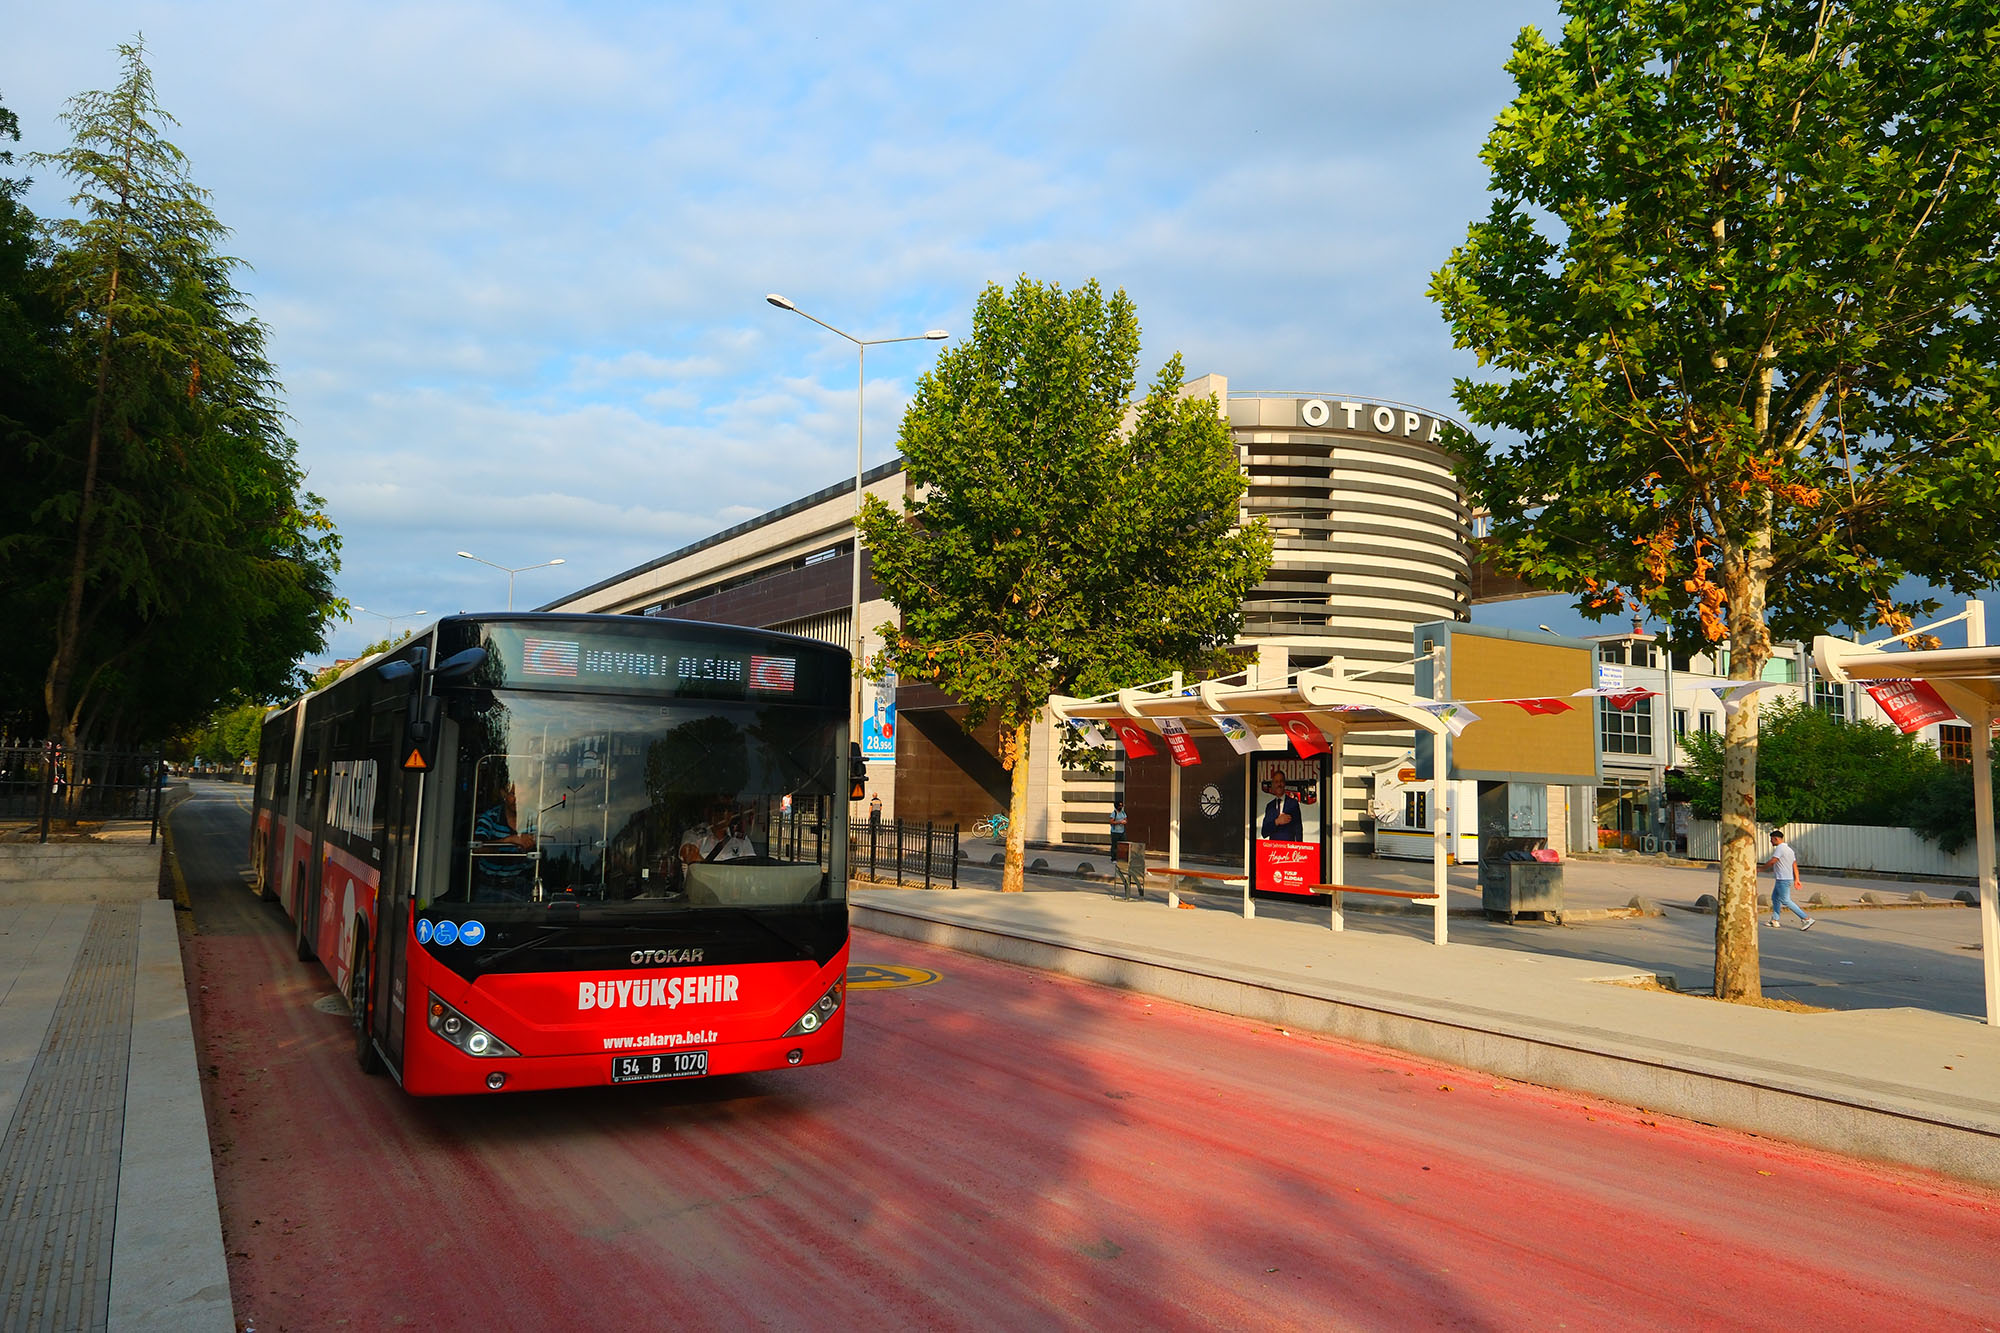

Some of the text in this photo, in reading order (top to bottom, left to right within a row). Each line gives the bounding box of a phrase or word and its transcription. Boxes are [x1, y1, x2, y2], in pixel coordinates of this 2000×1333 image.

[1302, 399, 1470, 449] OTOPA
[585, 650, 742, 681] HAYIRLI OLSUN
[1887, 692, 1918, 711] ESER
[1257, 760, 1320, 782] METROBÜS
[630, 948, 704, 965] OTOKAR
[578, 975, 739, 1009] BÜYÜKŞEHİR
[603, 1030, 718, 1048] www.sakarya.bel.tr
[622, 1053, 705, 1075] 54 B 1070
